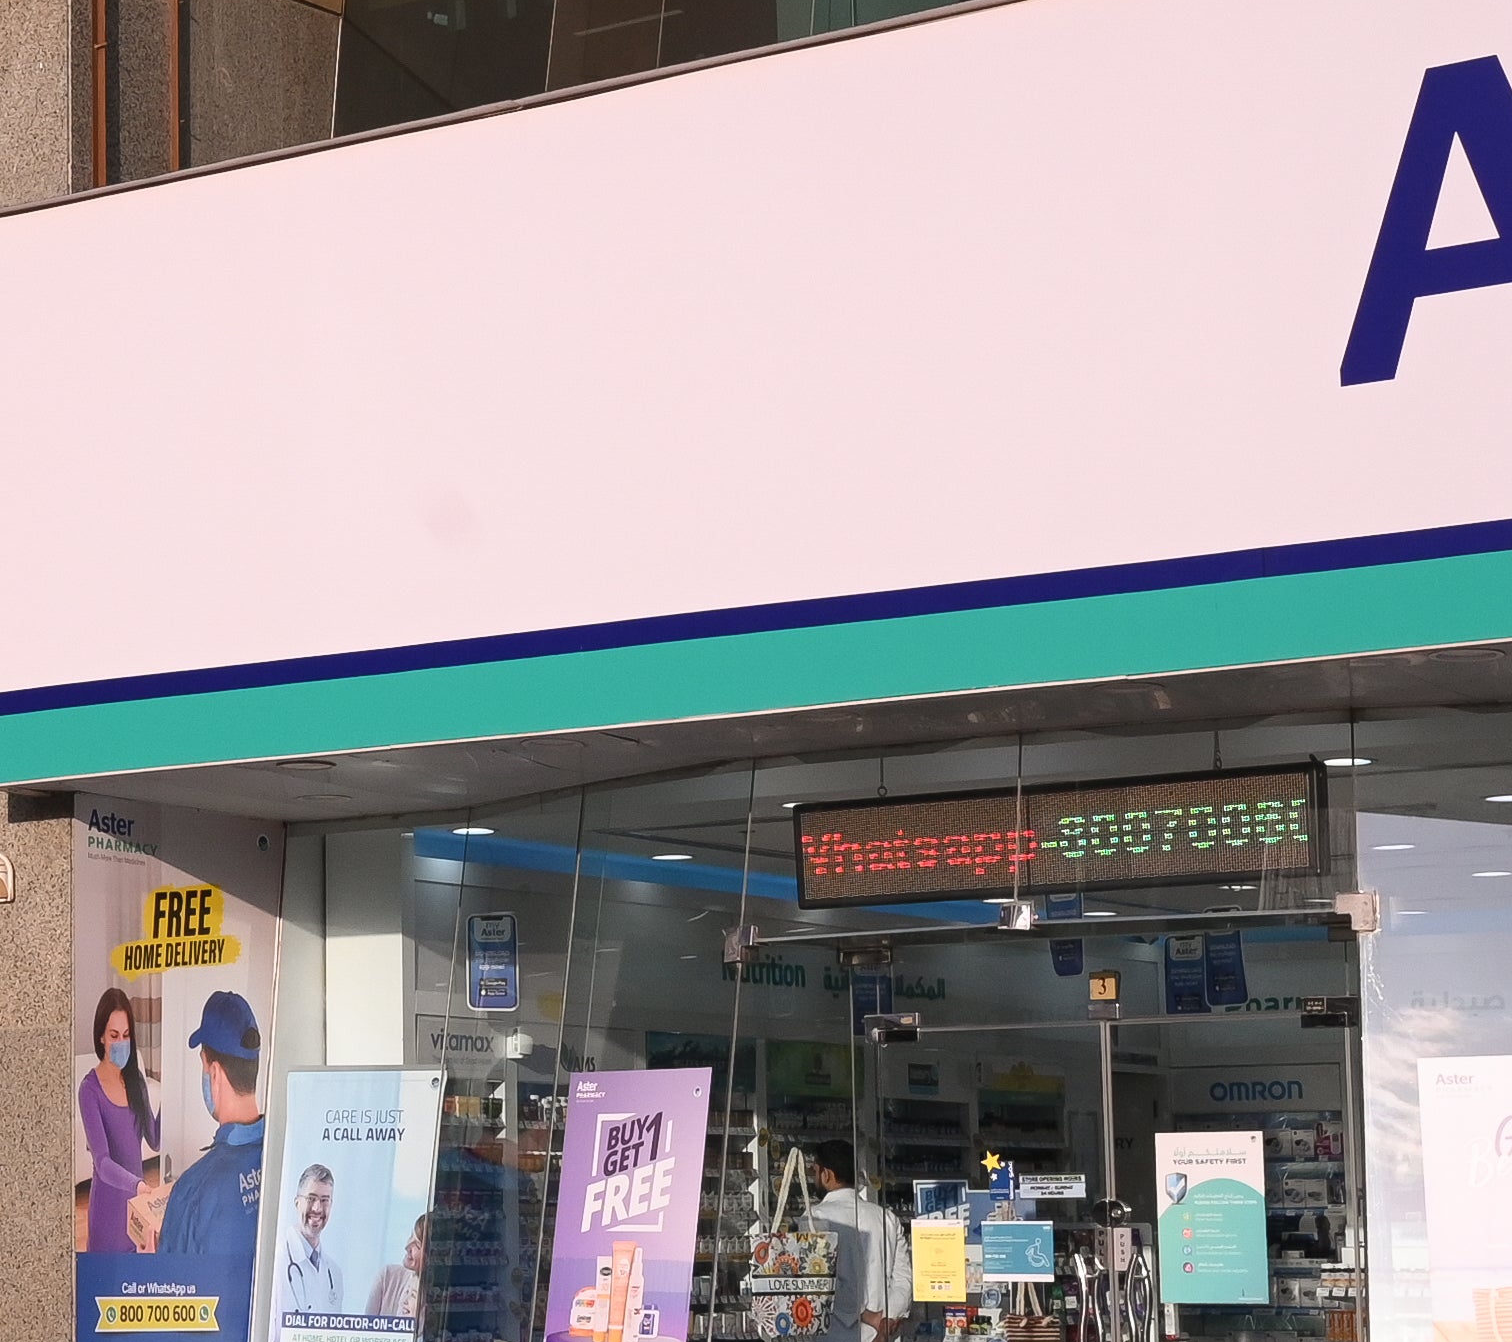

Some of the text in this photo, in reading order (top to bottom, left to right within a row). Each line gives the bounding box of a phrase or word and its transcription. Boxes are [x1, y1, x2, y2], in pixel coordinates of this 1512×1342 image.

[88, 809, 135, 837] Aster
[88, 836, 157, 856] PHARMACY
[153, 888, 213, 939] FREE
[480, 927, 506, 938] Aster
[124, 939, 225, 971] HOME DELIVERY
[1097, 978, 1107, 995] 3
[431, 1031, 494, 1053] vitamax
[576, 1080, 597, 1091] Aster
[1435, 1072, 1476, 1085] Aster
[326, 1109, 405, 1124] CARE IS JUST
[322, 1128, 405, 1142] A CALL AWAY
[607, 1111, 664, 1161] BUY 1
[603, 1142, 644, 1176] GET
[581, 1157, 675, 1234] FREE
[122, 1283, 196, 1296] Call or WhatsApp us
[769, 1279, 791, 1291] LOVE
[120, 1304, 196, 1322] 800 700 600
[285, 1314, 415, 1331] DIAL FOR DOCTOR-ON-CALL
